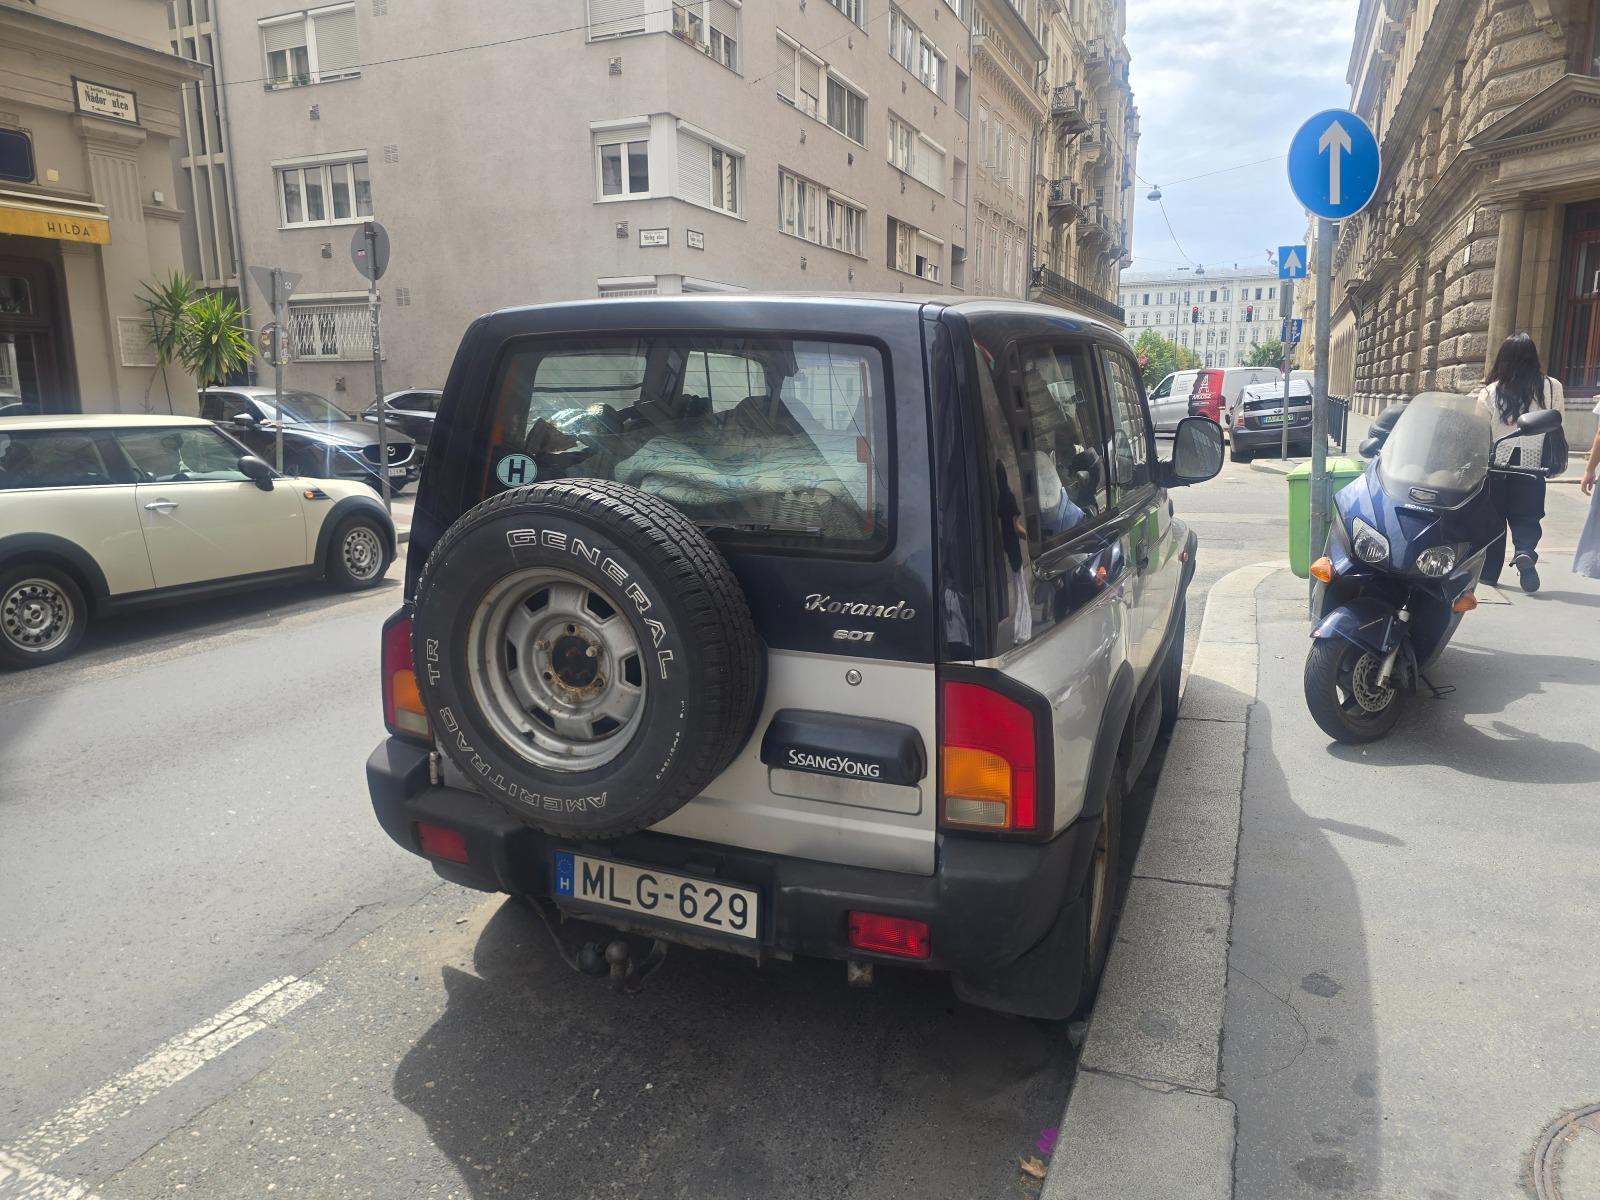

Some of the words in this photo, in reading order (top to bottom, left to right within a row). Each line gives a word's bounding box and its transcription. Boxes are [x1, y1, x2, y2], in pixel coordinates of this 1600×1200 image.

[85, 90, 106, 105] Nádor
[112, 99, 129, 110] utca
[47, 222, 90, 237] HILDA
[508, 459, 525, 483] H
[1405, 503, 1434, 512] HONDA
[506, 529, 674, 680] GENERAL
[805, 593, 916, 620] Korando
[833, 629, 875, 642] 601
[426, 638, 441, 686] TR
[560, 877, 570, 890] H
[582, 861, 748, 931] MLG-629
